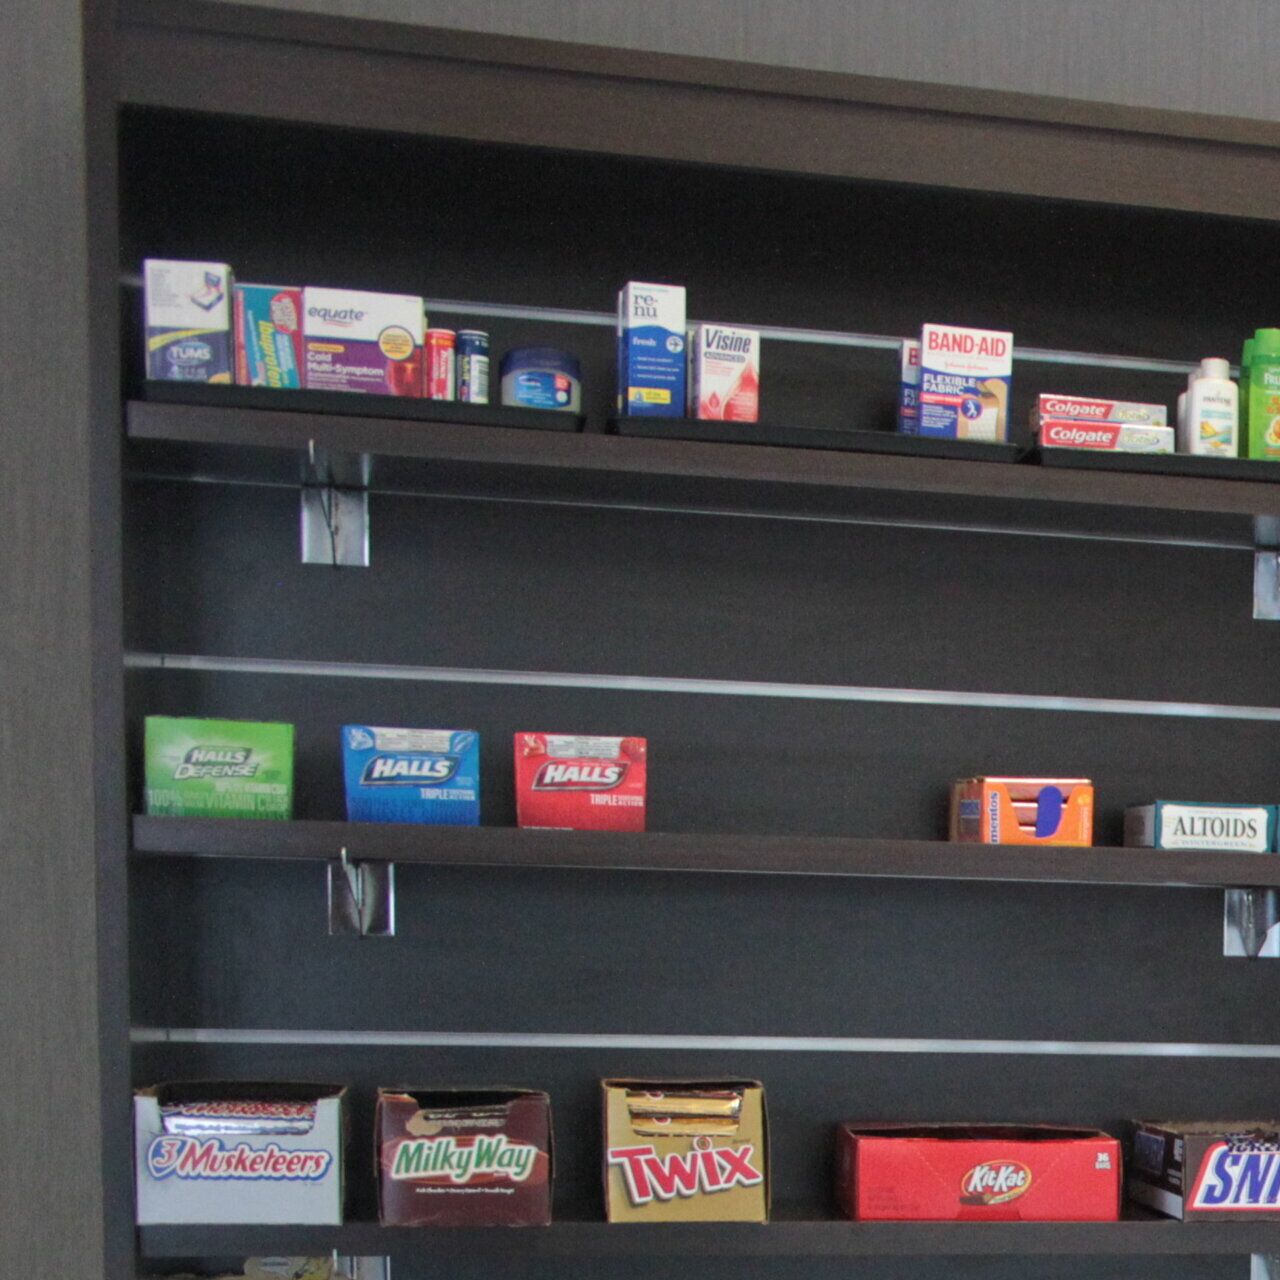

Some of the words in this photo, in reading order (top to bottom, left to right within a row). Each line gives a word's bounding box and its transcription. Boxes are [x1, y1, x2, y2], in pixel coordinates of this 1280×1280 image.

[308, 306, 364, 322] equate
[632, 336, 656, 347] fresh
[704, 328, 751, 353] Visine
[928, 331, 1006, 358] BAND-AID
[171, 347, 211, 360] TUMS
[307, 352, 332, 362] Cold
[307, 363, 384, 376] Multi-Symptom
[923, 373, 976, 388] FLEXIBLE
[923, 383, 964, 395] FABRIC
[1045, 401, 1105, 417] Colgate
[1049, 427, 1113, 444] Colgate
[191, 750, 245, 763] HALLS
[175, 764, 258, 779] DEFENSE
[372, 759, 451, 778] HALLS
[544, 765, 621, 783] HALLS
[591, 794, 618, 806] TRIPLE
[989, 791, 1000, 844] mentos
[1173, 816, 1257, 839] ALTOIDS
[154, 1142, 177, 1167] 3
[179, 1141, 326, 1174] Musketeers
